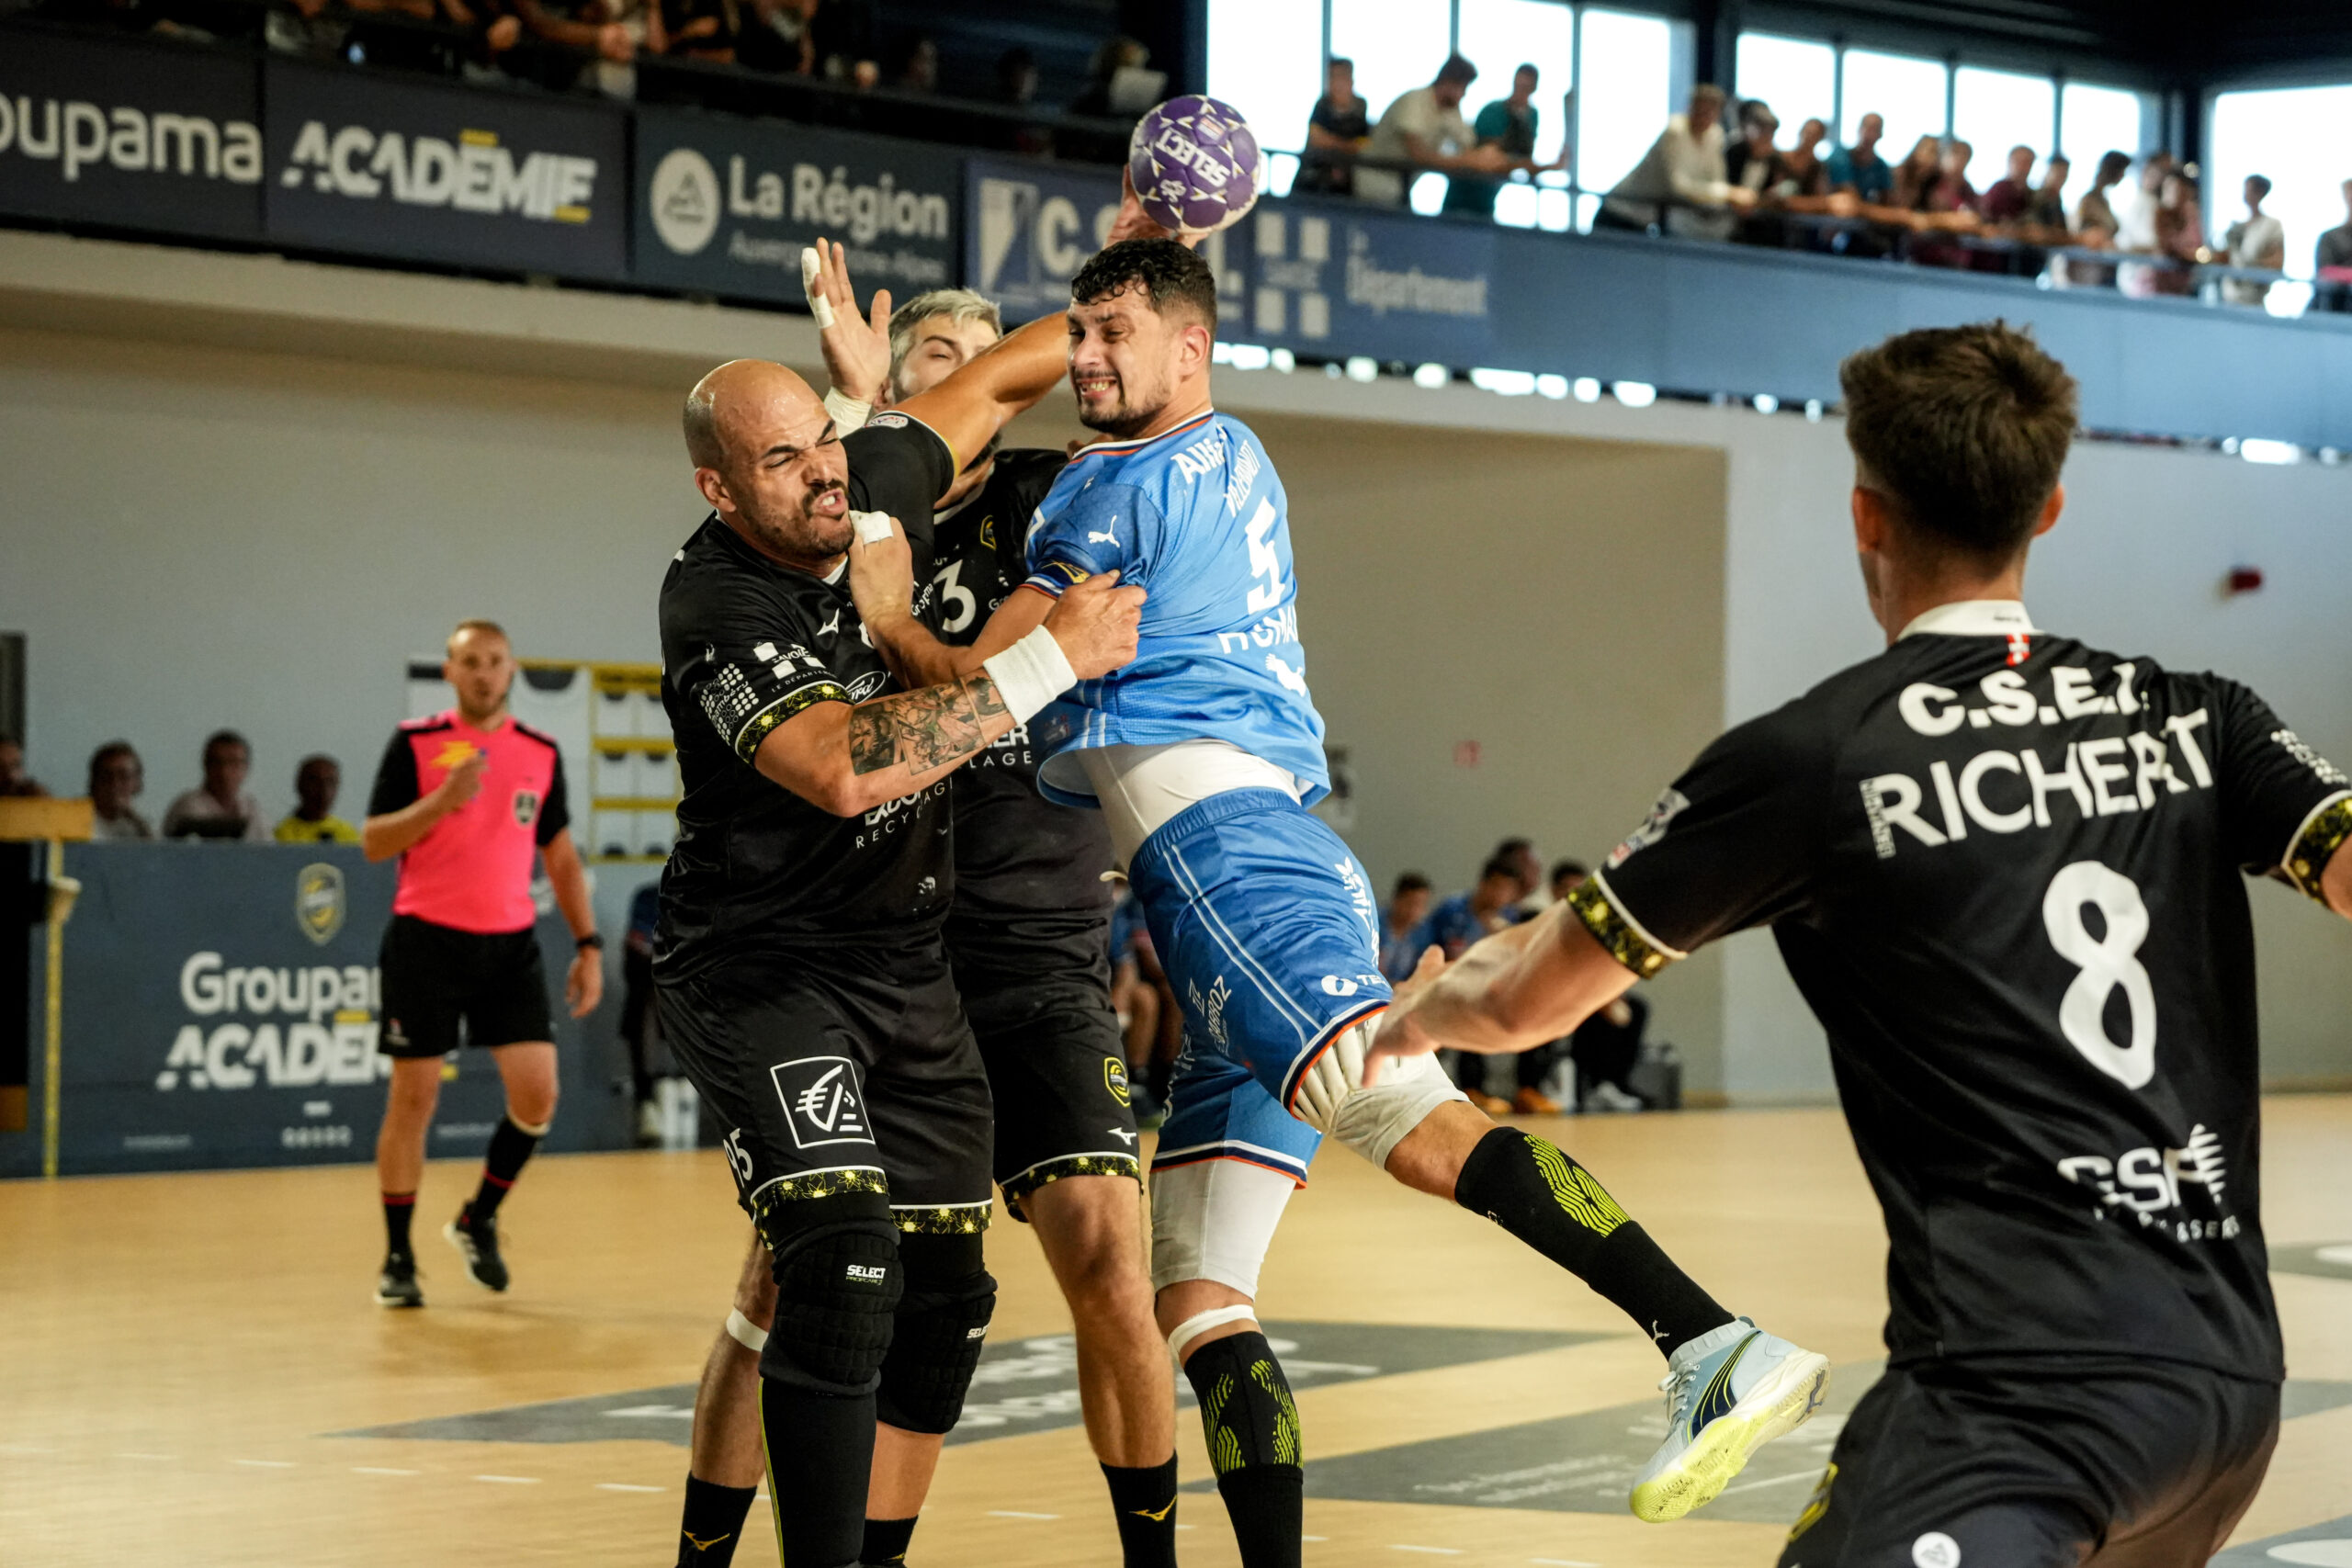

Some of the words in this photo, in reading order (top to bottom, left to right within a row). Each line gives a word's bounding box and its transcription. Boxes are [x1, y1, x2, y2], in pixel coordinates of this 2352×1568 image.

[1155, 126, 1231, 187] SELECT
[728, 153, 785, 220] La
[792, 163, 950, 246] Région
[933, 558, 977, 633] 3
[1245, 495, 1285, 615] 5
[1859, 710, 2214, 861] RICHERT
[180, 951, 382, 1023] Groupa
[2043, 860, 2157, 1090] 8
[847, 1264, 887, 1280] SELECT
